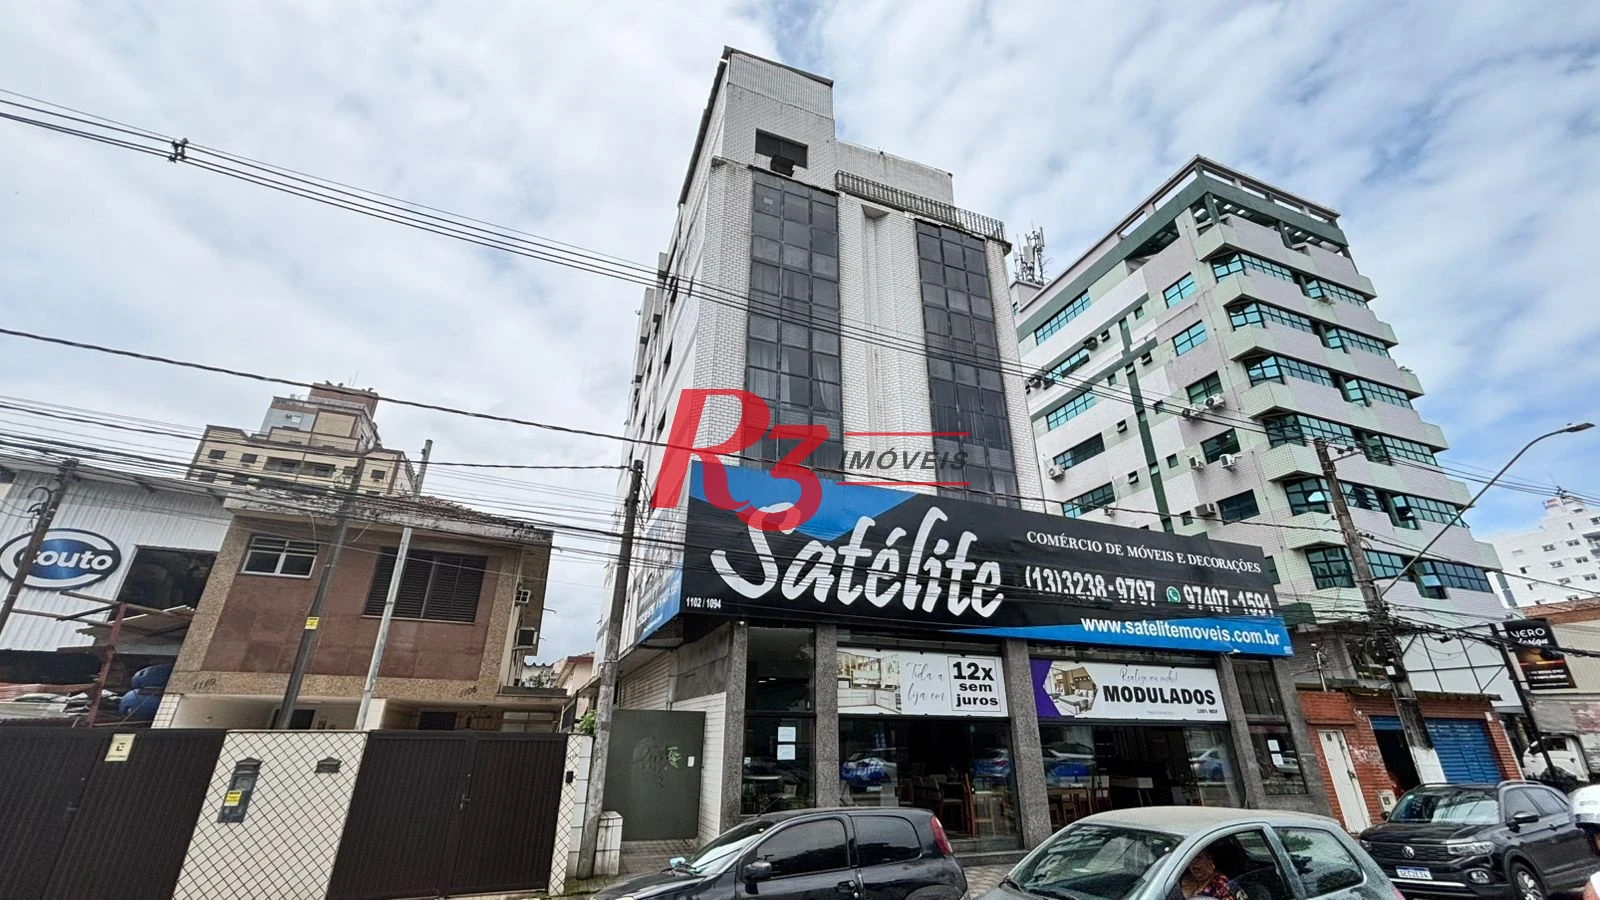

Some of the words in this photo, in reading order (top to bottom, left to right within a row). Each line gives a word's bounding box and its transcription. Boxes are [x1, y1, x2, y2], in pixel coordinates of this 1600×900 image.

[20, 550, 113, 571] outo
[710, 502, 1004, 618] Satélite
[1026, 531, 1102, 553] COMÉRCIO
[1104, 542, 1124, 556] DE
[1126, 545, 1175, 562] MÓVEIS
[1176, 552, 1186, 564] E
[1187, 554, 1261, 574] DECORAÇÕES
[686, 597, 701, 608] 1102
[1081, 618, 1280, 645] www.satelitemoveis.com.br
[1510, 628, 1545, 638] VERO
[953, 661, 995, 681] 12x
[959, 683, 993, 693] sem
[1102, 685, 1216, 705] MODULADOS
[956, 694, 999, 707] juros
